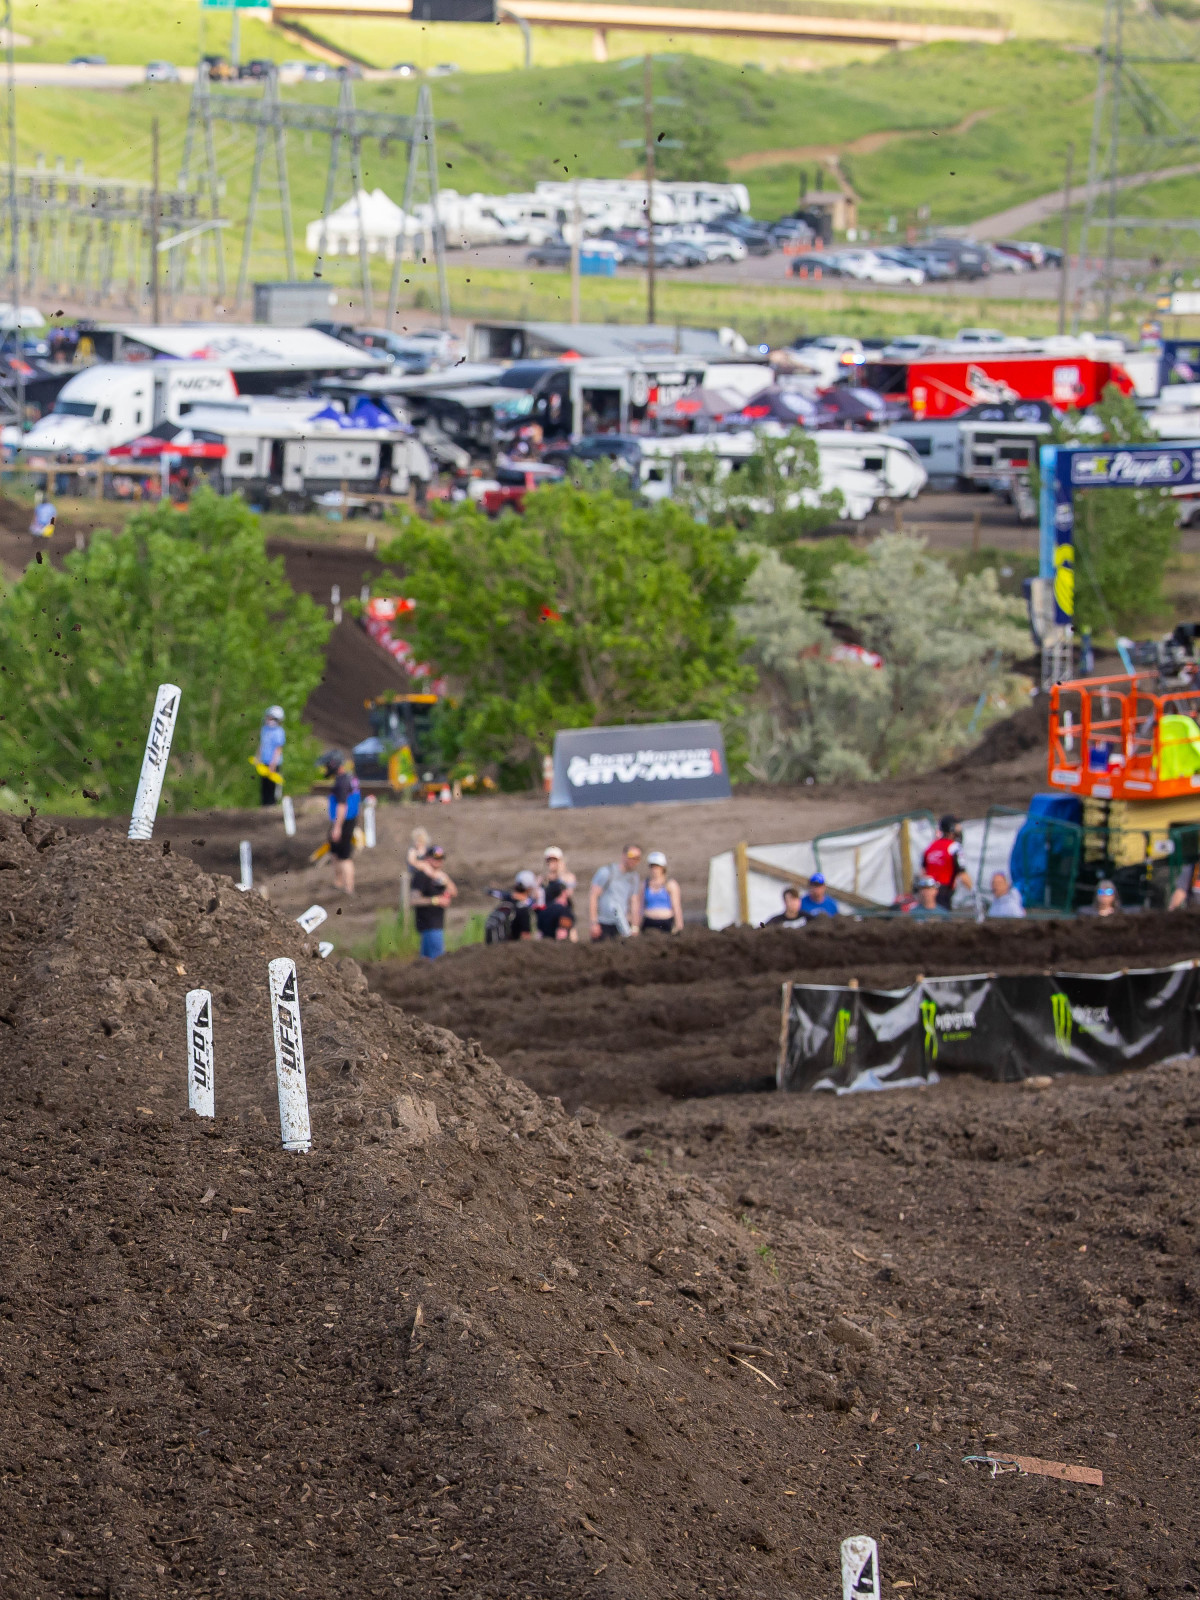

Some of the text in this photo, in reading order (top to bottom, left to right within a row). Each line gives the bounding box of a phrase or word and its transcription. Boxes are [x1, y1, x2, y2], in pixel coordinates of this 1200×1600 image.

[147, 716, 165, 768] UFO
[192, 1029, 208, 1088] UFO
[277, 1003, 297, 1071] UFO
